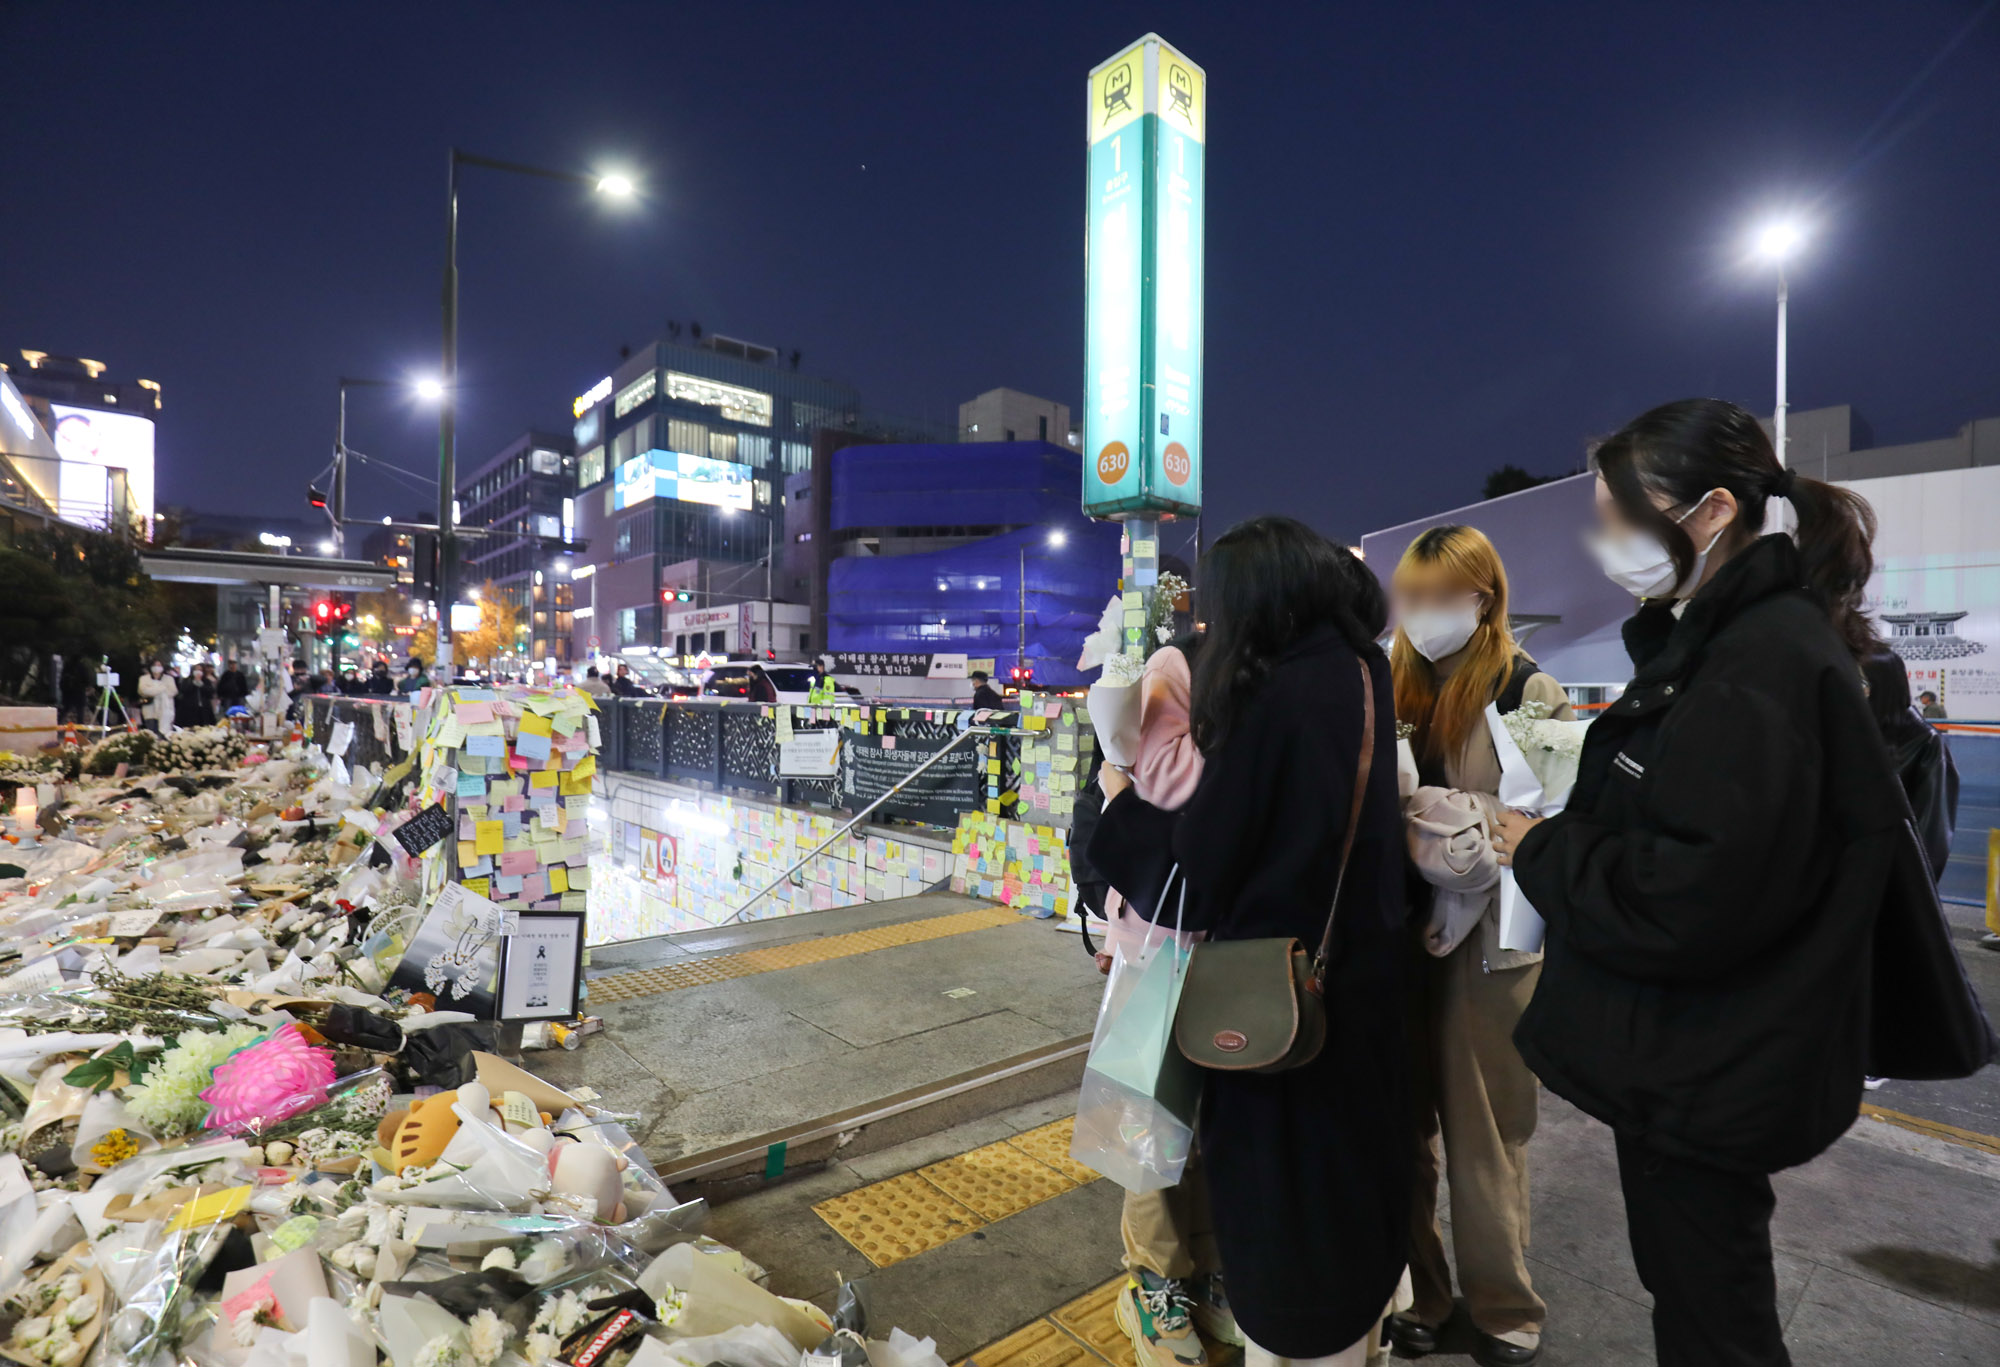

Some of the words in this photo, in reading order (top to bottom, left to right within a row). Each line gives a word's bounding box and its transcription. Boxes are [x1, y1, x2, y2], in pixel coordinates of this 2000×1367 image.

[1110, 135, 1121, 173] 1
[1174, 136, 1184, 174] 1
[1100, 452, 1126, 473] 630
[1165, 454, 1188, 475] 630
[838, 653, 866, 664] 이태원
[869, 654, 888, 665] 참사
[891, 654, 927, 665] 희생자의
[854, 664, 881, 675] 명복을
[885, 664, 912, 675] 빕니다
[870, 747, 883, 759] 참사
[884, 749, 917, 761] 희생자들께
[578, 1314, 632, 1365] KOPIKO
